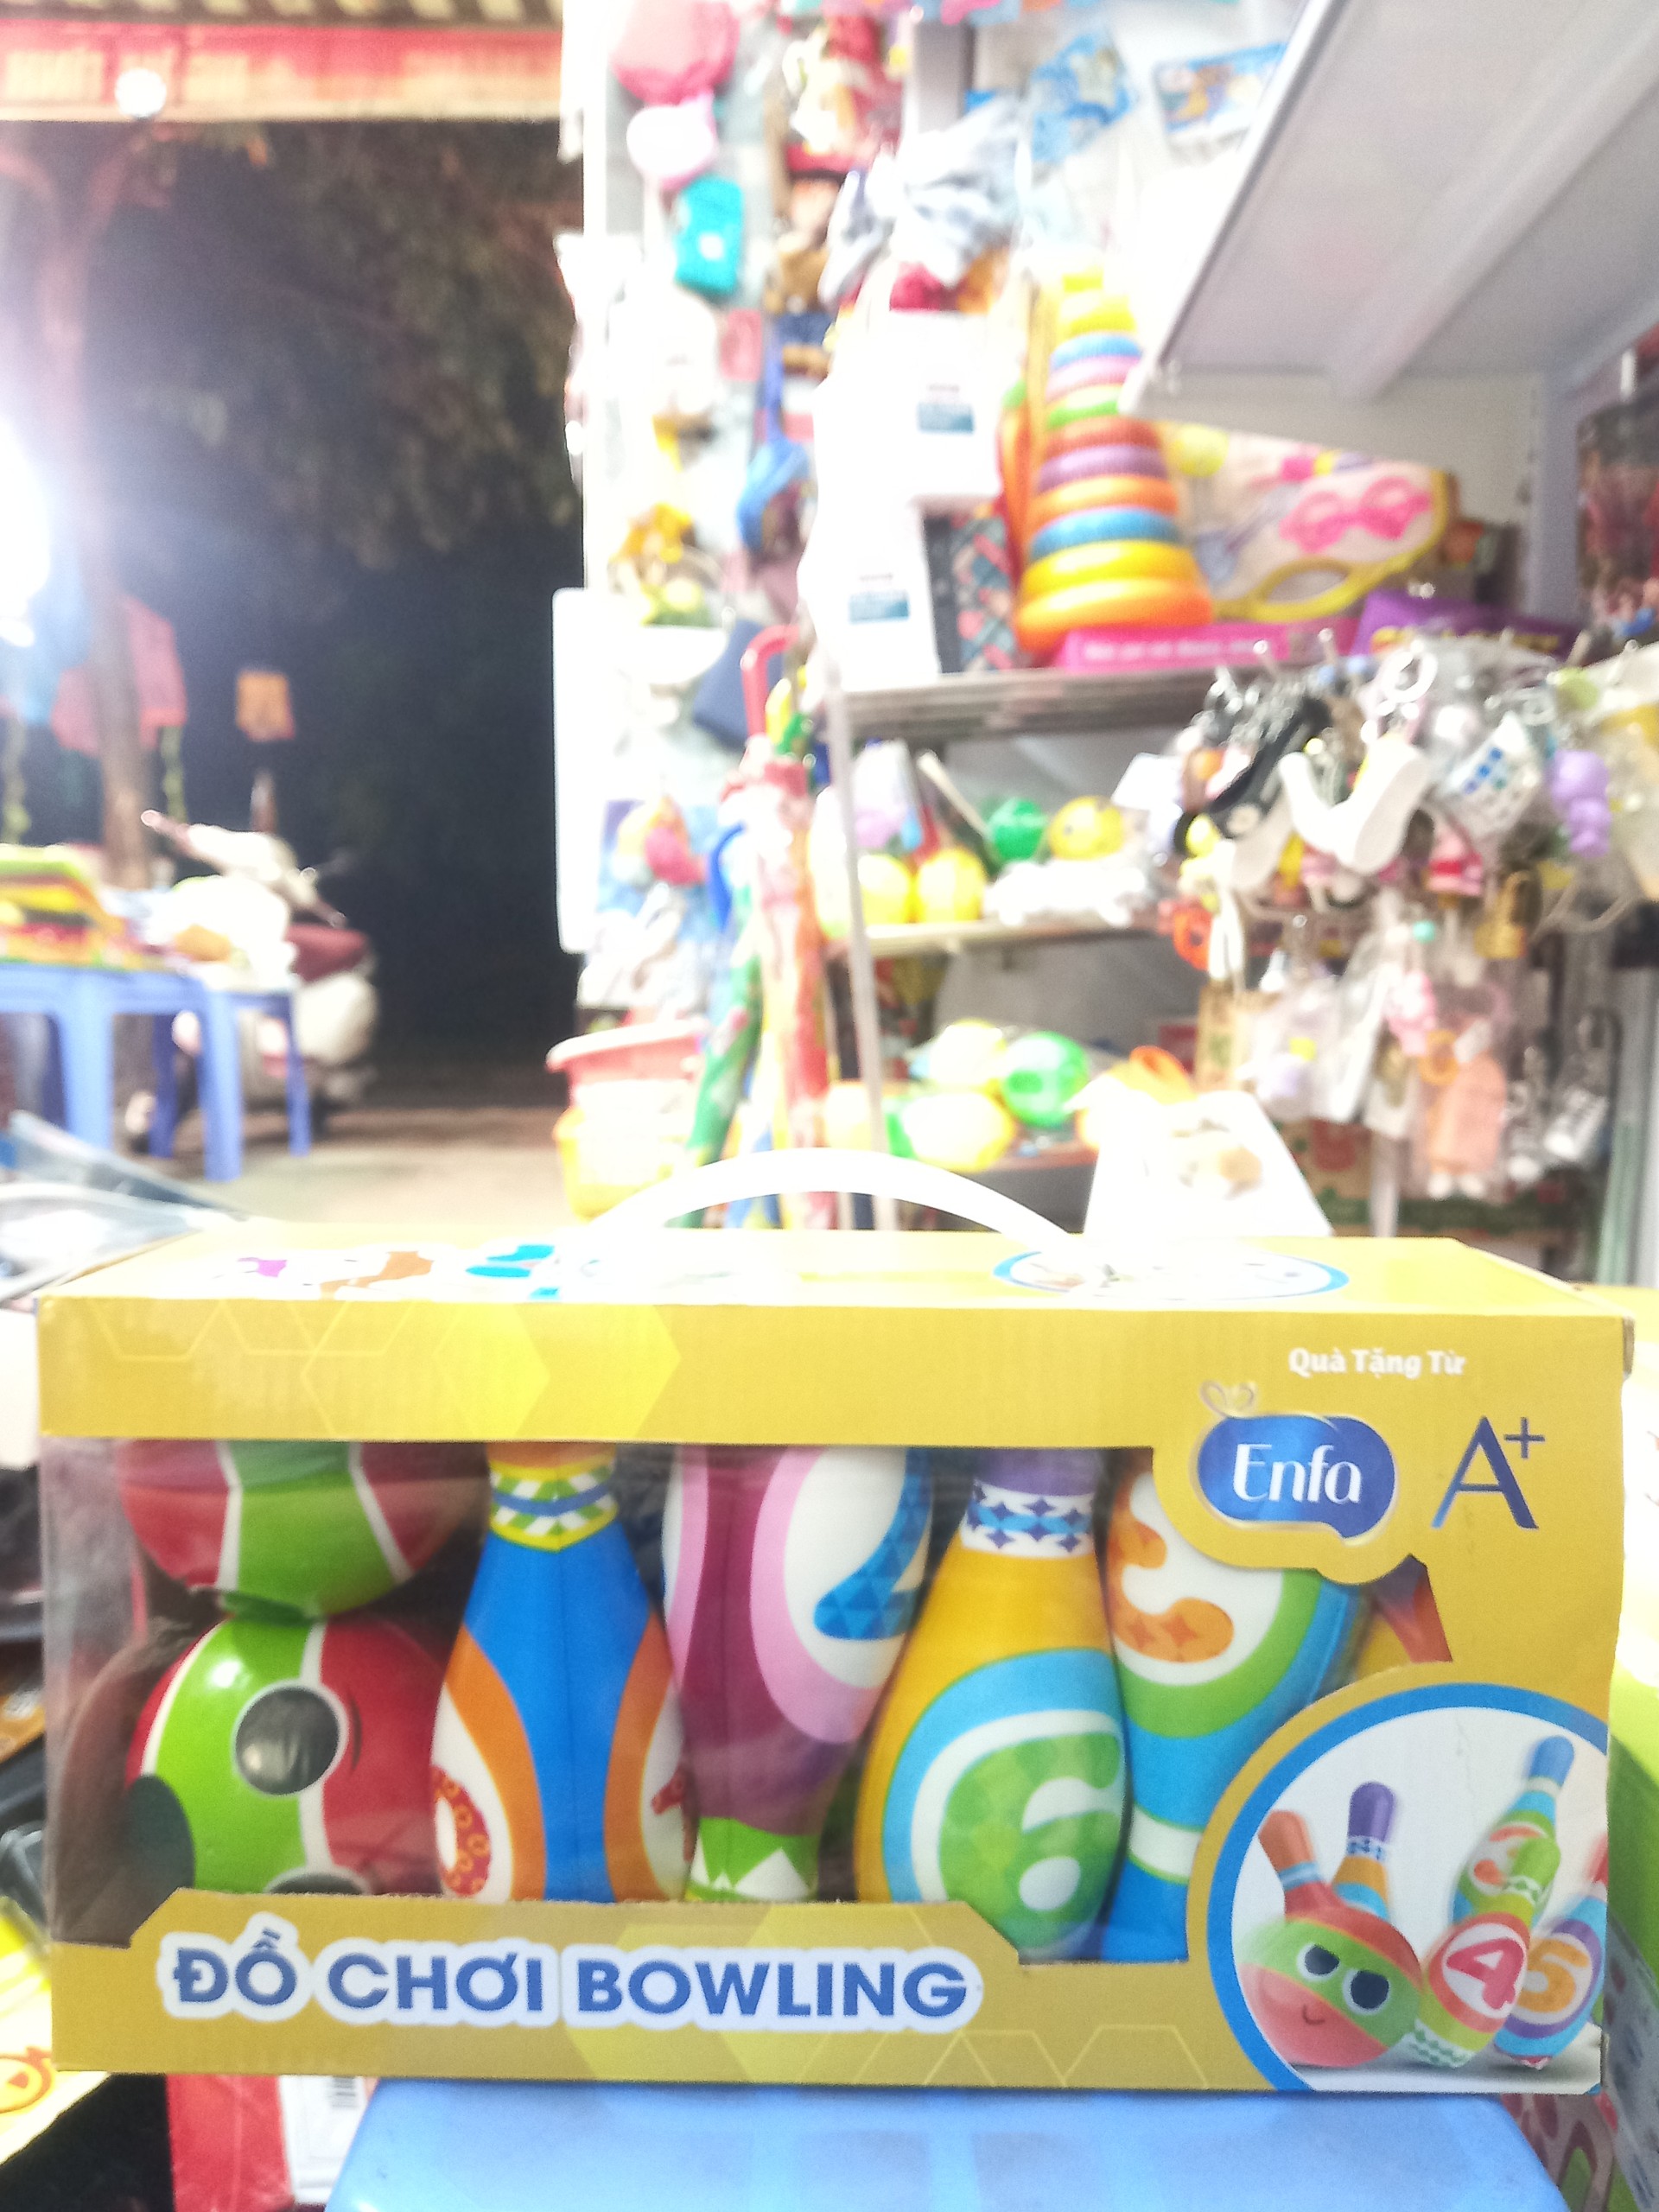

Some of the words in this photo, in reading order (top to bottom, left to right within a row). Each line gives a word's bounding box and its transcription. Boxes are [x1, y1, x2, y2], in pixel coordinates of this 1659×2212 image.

[1288, 1347, 1347, 1377] Quà
[1352, 1349, 1421, 1379] Tặng
[1427, 1350, 1466, 1376] Từ
[1232, 1443, 1363, 1505] Enfa
[173, 1928, 298, 2006] ĐỒ
[328, 1948, 543, 2012] CHƠI
[576, 1958, 969, 2019] BOWLING
[1445, 1936, 1526, 2011] 4
[1522, 1939, 1592, 2012] 5
